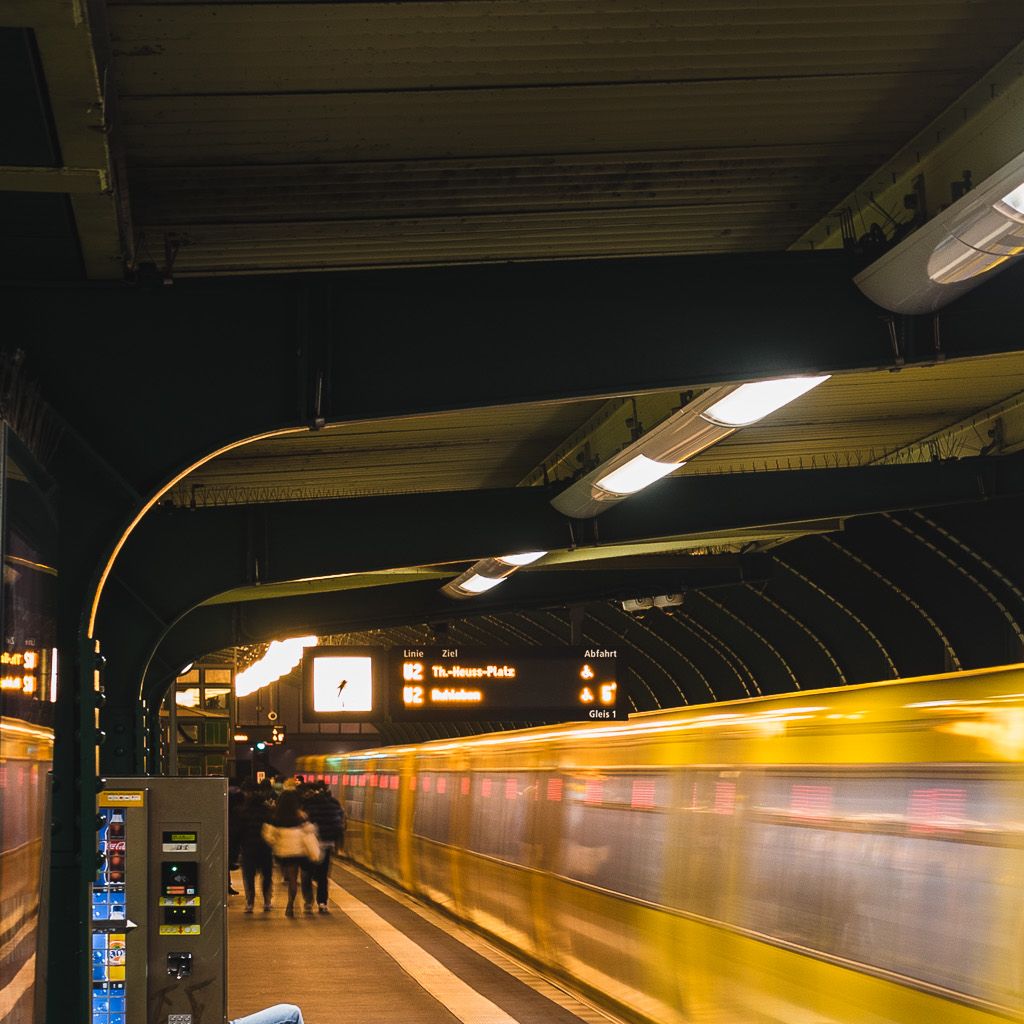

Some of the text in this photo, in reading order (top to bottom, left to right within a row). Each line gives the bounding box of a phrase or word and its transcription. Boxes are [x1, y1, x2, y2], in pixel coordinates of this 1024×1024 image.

[403, 649, 424, 658] Linie
[442, 649, 458, 658] Ziel
[584, 649, 617, 658] Abfahrt
[589, 710, 610, 719] Gleis
